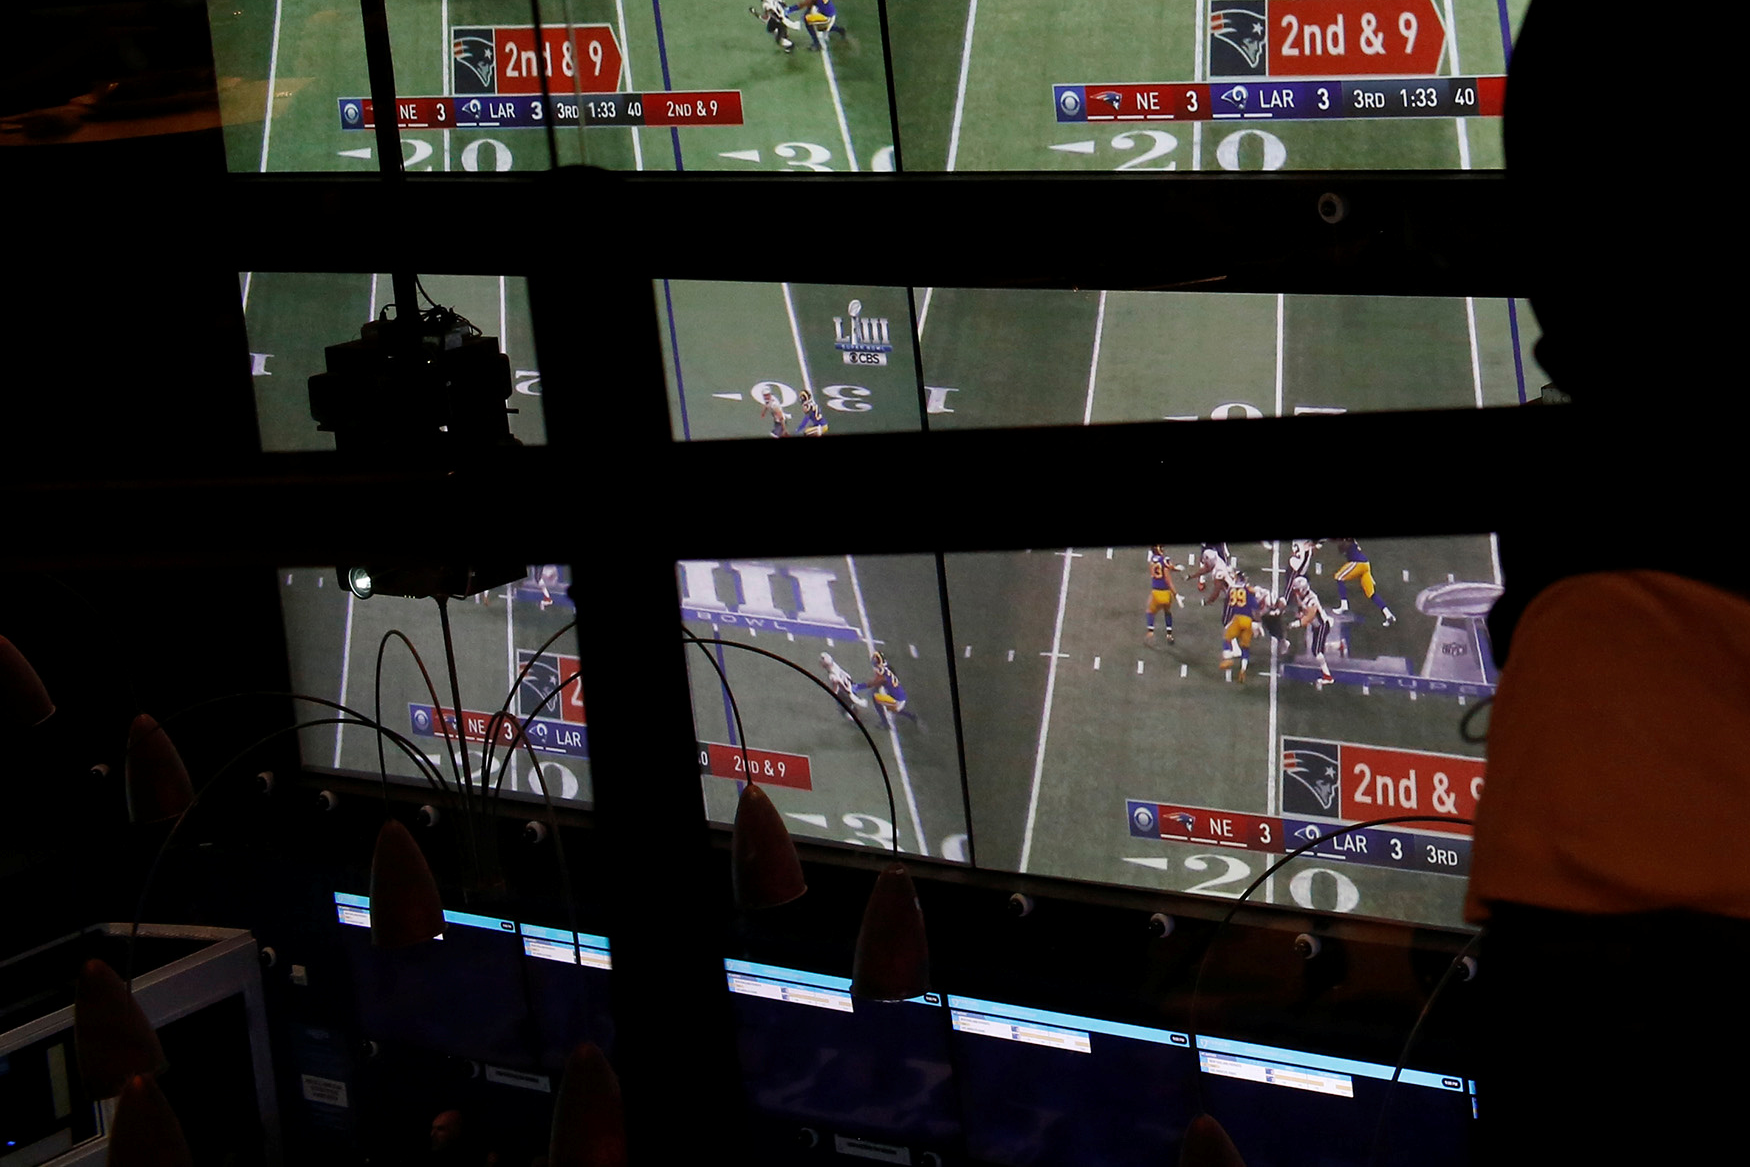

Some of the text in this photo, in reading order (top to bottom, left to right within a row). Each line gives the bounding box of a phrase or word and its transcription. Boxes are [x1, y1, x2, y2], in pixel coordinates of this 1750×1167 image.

[1281, 11, 1417, 57] 2nd & 9
[588, 41, 603, 76] 9
[400, 99, 719, 122] NE 3 LAR 3 3RD 1:33 40 2ND & 9
[1136, 86, 1476, 113] NE 3 LAR 3 3RD 1:33 40
[859, 353, 880, 365] CBS
[696, 611, 788, 632] BOWL
[468, 718, 582, 747] NE 3 LAR
[764, 759, 776, 776] &
[778, 761, 786, 778] 9
[1354, 763, 1417, 810] 2nd
[1432, 771, 1458, 815] &
[1210, 817, 1459, 867] NE 3 LAR 3 3RD
